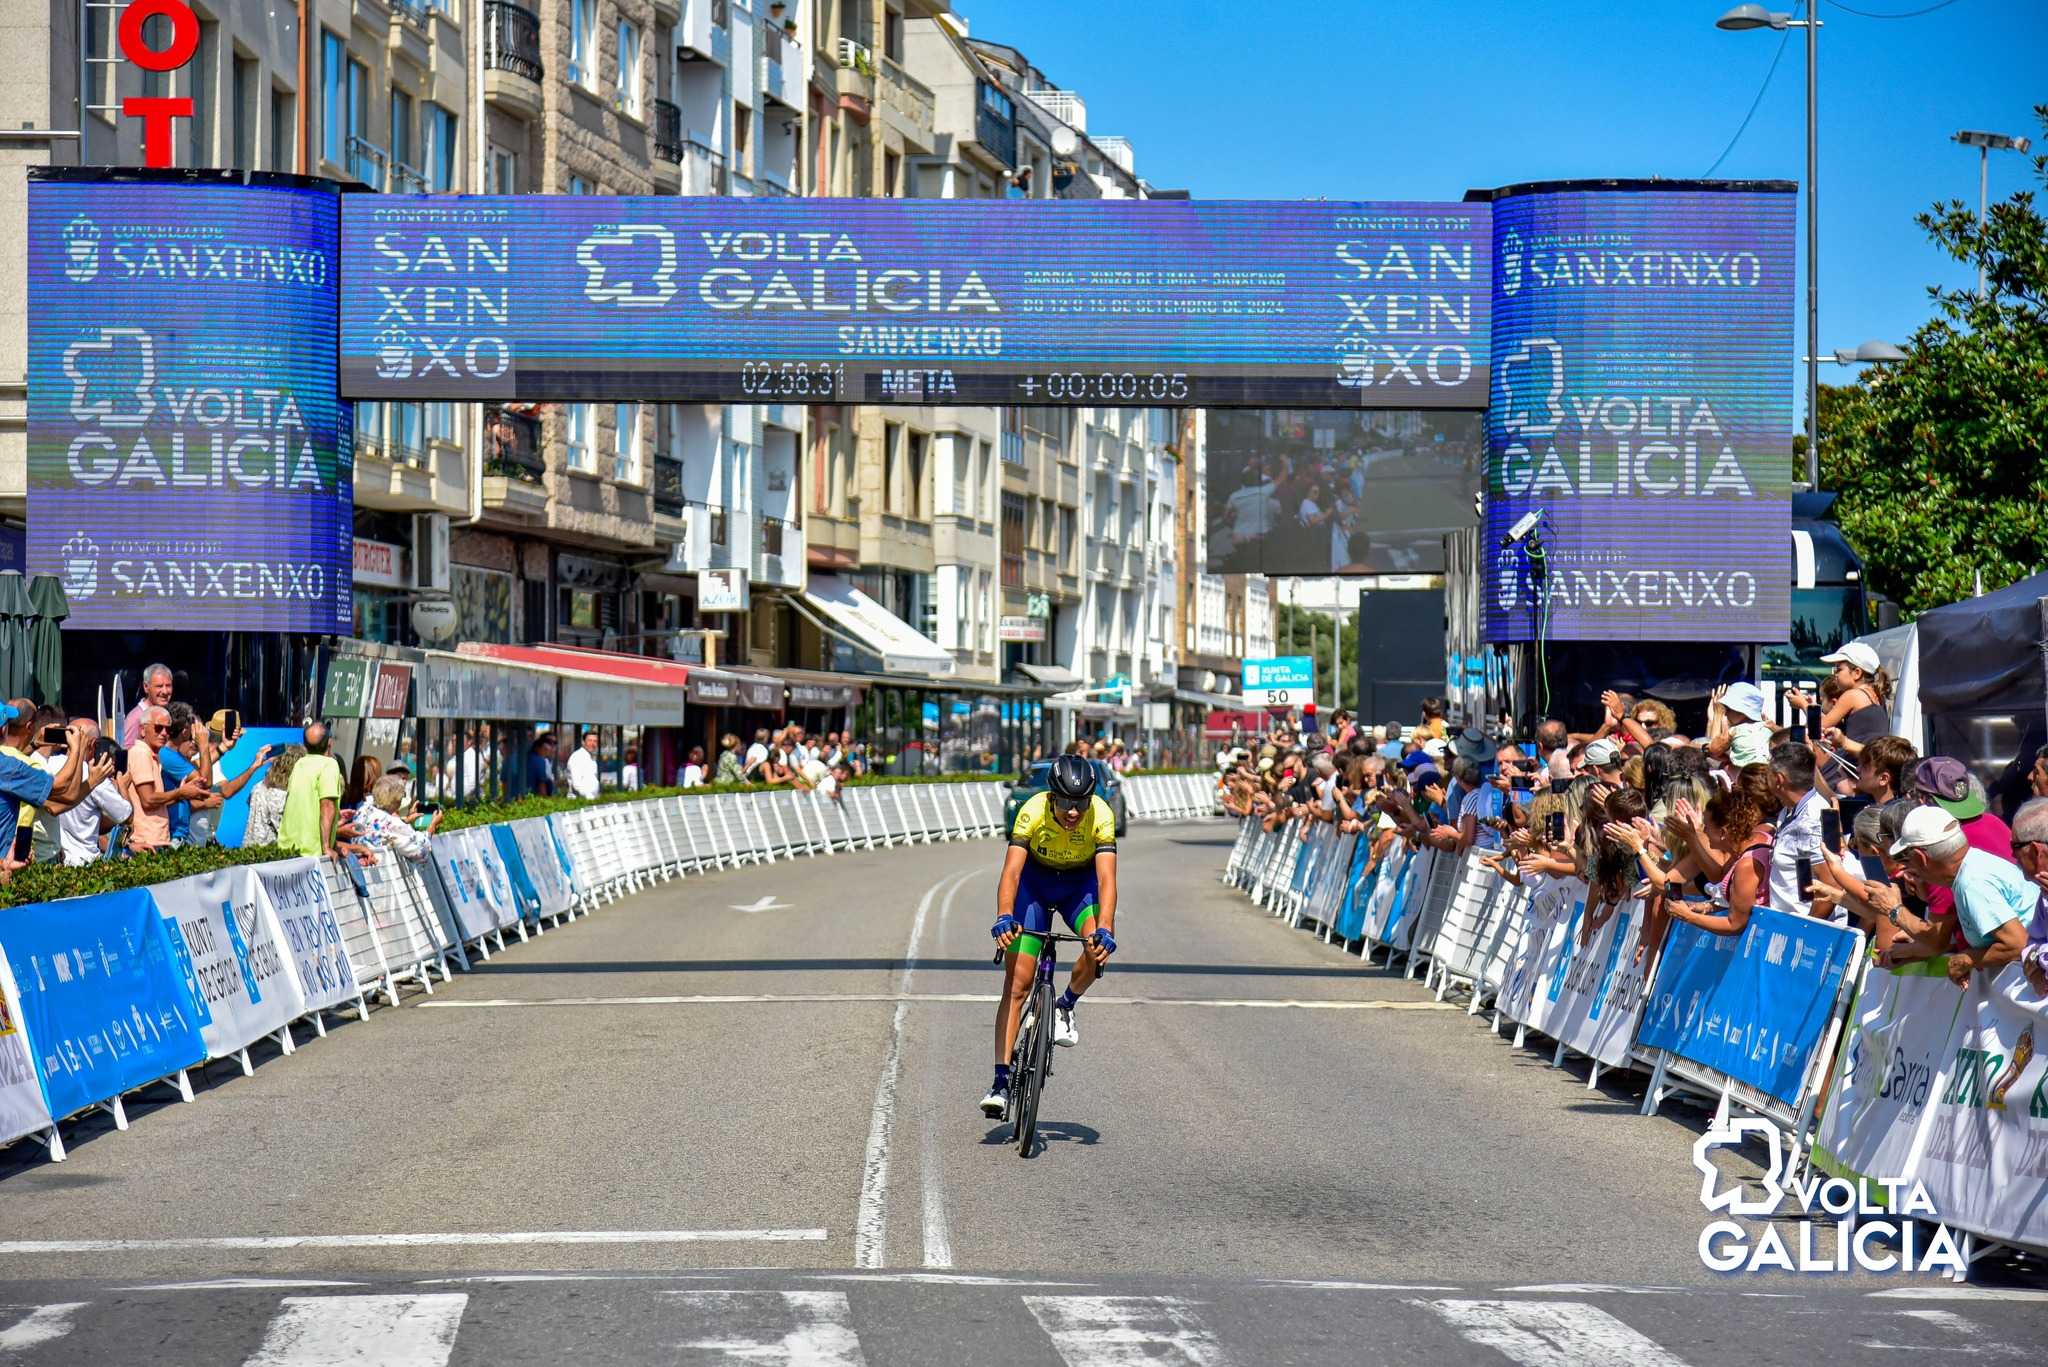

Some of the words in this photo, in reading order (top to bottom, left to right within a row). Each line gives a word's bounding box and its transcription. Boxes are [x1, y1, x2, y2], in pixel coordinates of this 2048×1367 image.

[373, 208, 478, 223] CONCELLO
[483, 209, 509, 223] DE
[1335, 216, 1439, 231] CONCELLO
[1444, 217, 1472, 231] DE
[112, 243, 325, 287] SANXENXO
[373, 231, 509, 274] SAN
[700, 231, 863, 261] VOLTA
[1335, 239, 1472, 283] SAN
[699, 267, 1001, 312] GALICIA
[1023, 271, 1075, 286] SARRIA
[1090, 271, 1133, 286] XINZO
[1136, 271, 1154, 286] DE
[1157, 271, 1197, 286] LIMIA
[1212, 271, 1286, 286] SANXENXO
[1530, 251, 1761, 288] SANXENXO
[373, 286, 509, 326] XEN
[1335, 293, 1471, 335] XEN
[417, 336, 510, 378] XO
[838, 324, 1002, 355] SANXENXO
[880, 368, 957, 394] META
[1017, 371, 1189, 399] +00:00:05
[1379, 343, 1472, 387] XO
[162, 387, 304, 431] VOLTA
[1568, 395, 1722, 438] VOLTA
[67, 431, 323, 490] GALICIA
[1502, 440, 1753, 496] GALICIA
[112, 558, 325, 601] SANXENXO
[1261, 665, 1292, 674] XUNTA
[1261, 673, 1273, 683] DE
[1274, 673, 1310, 682] GALICIA
[1267, 690, 1289, 704] 50
